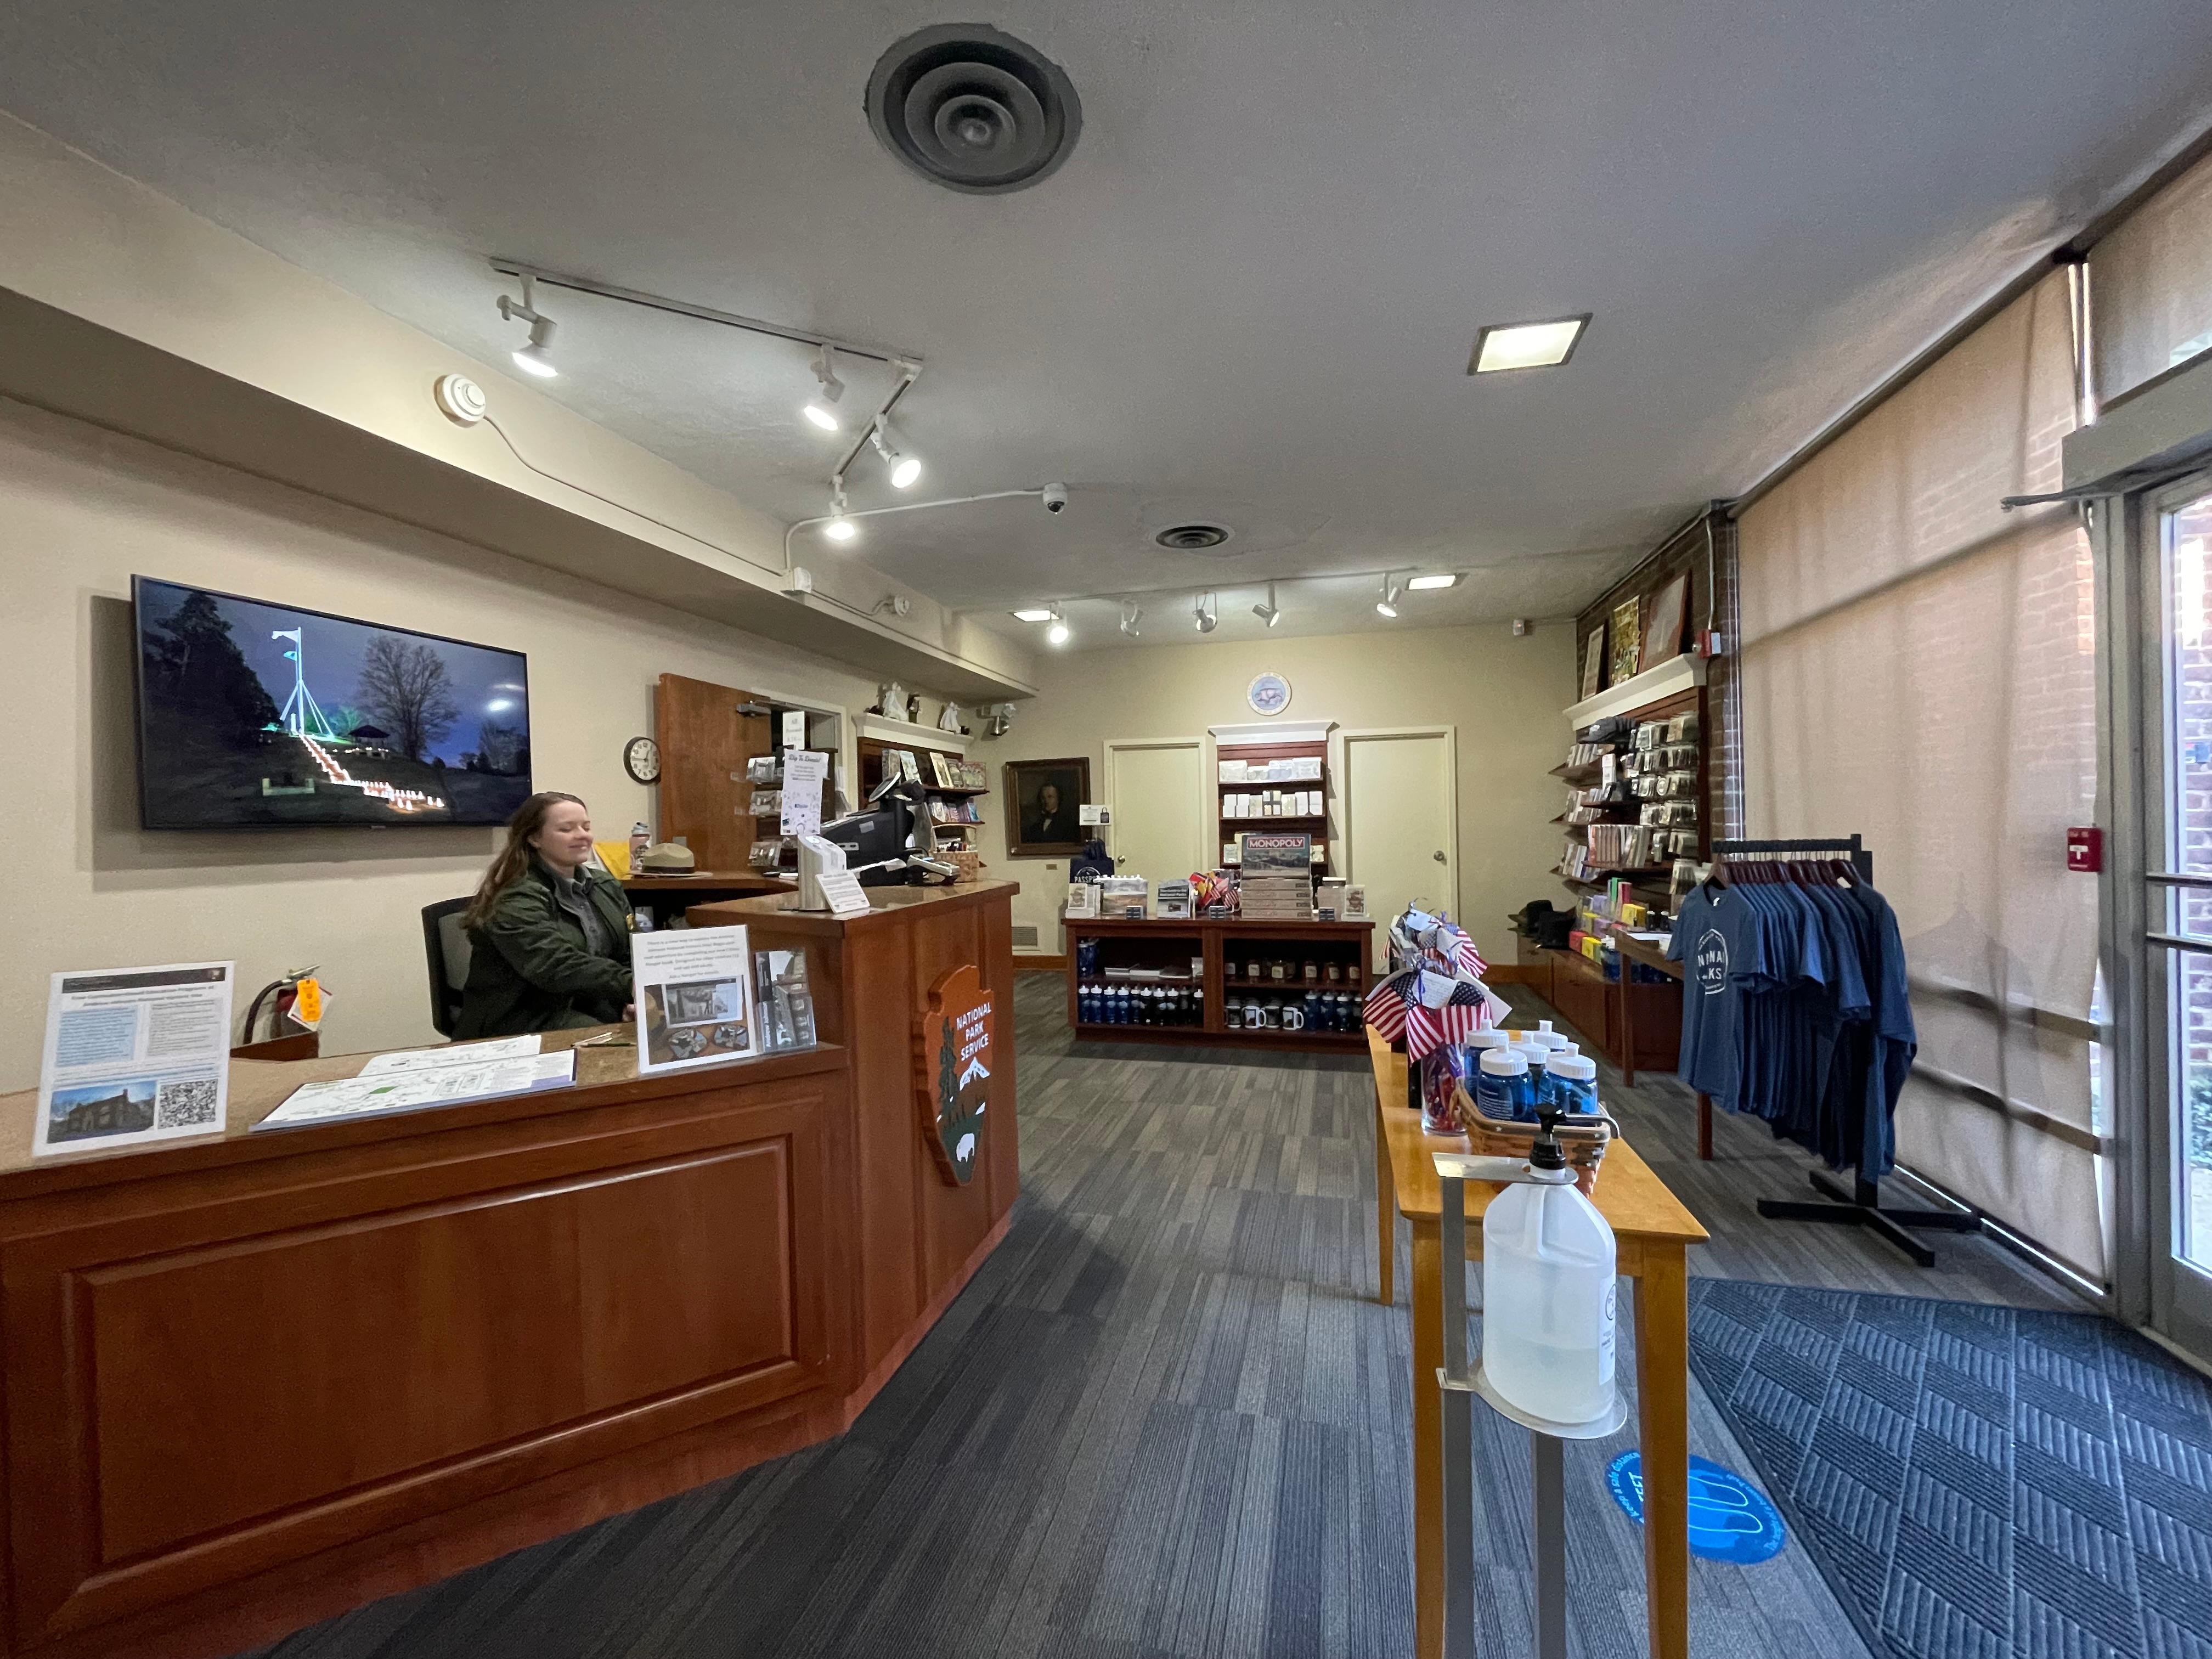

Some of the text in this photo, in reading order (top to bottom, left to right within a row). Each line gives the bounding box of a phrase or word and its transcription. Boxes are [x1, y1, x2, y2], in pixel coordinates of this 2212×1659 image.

[1249, 839, 1303, 848] MONOPOLY
[956, 1002, 991, 1030] NATIONAL
[966, 1020, 984, 1041] PARK
[961, 1033, 989, 1061] SERVICE
